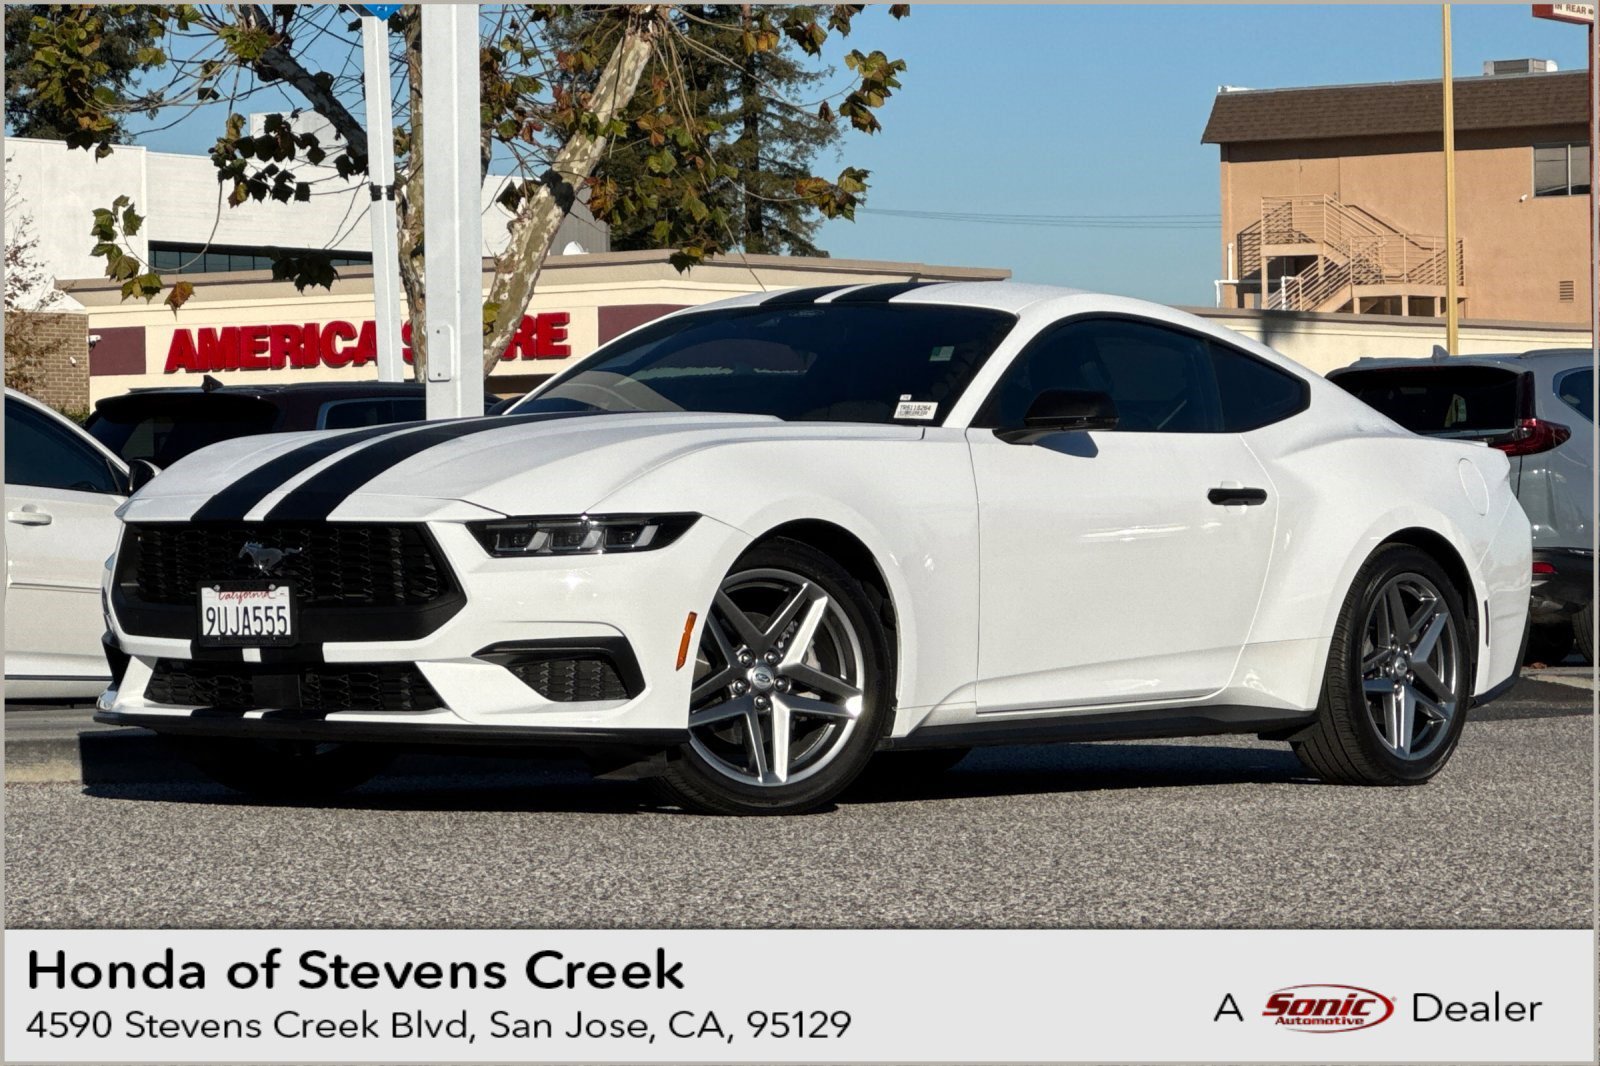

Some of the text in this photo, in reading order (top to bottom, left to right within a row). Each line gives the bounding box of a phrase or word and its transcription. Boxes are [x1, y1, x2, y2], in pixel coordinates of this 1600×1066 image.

[1566, 4, 1587, 13] REAR
[218, 591, 276, 604] California
[206, 606, 288, 635] 9UJA555
